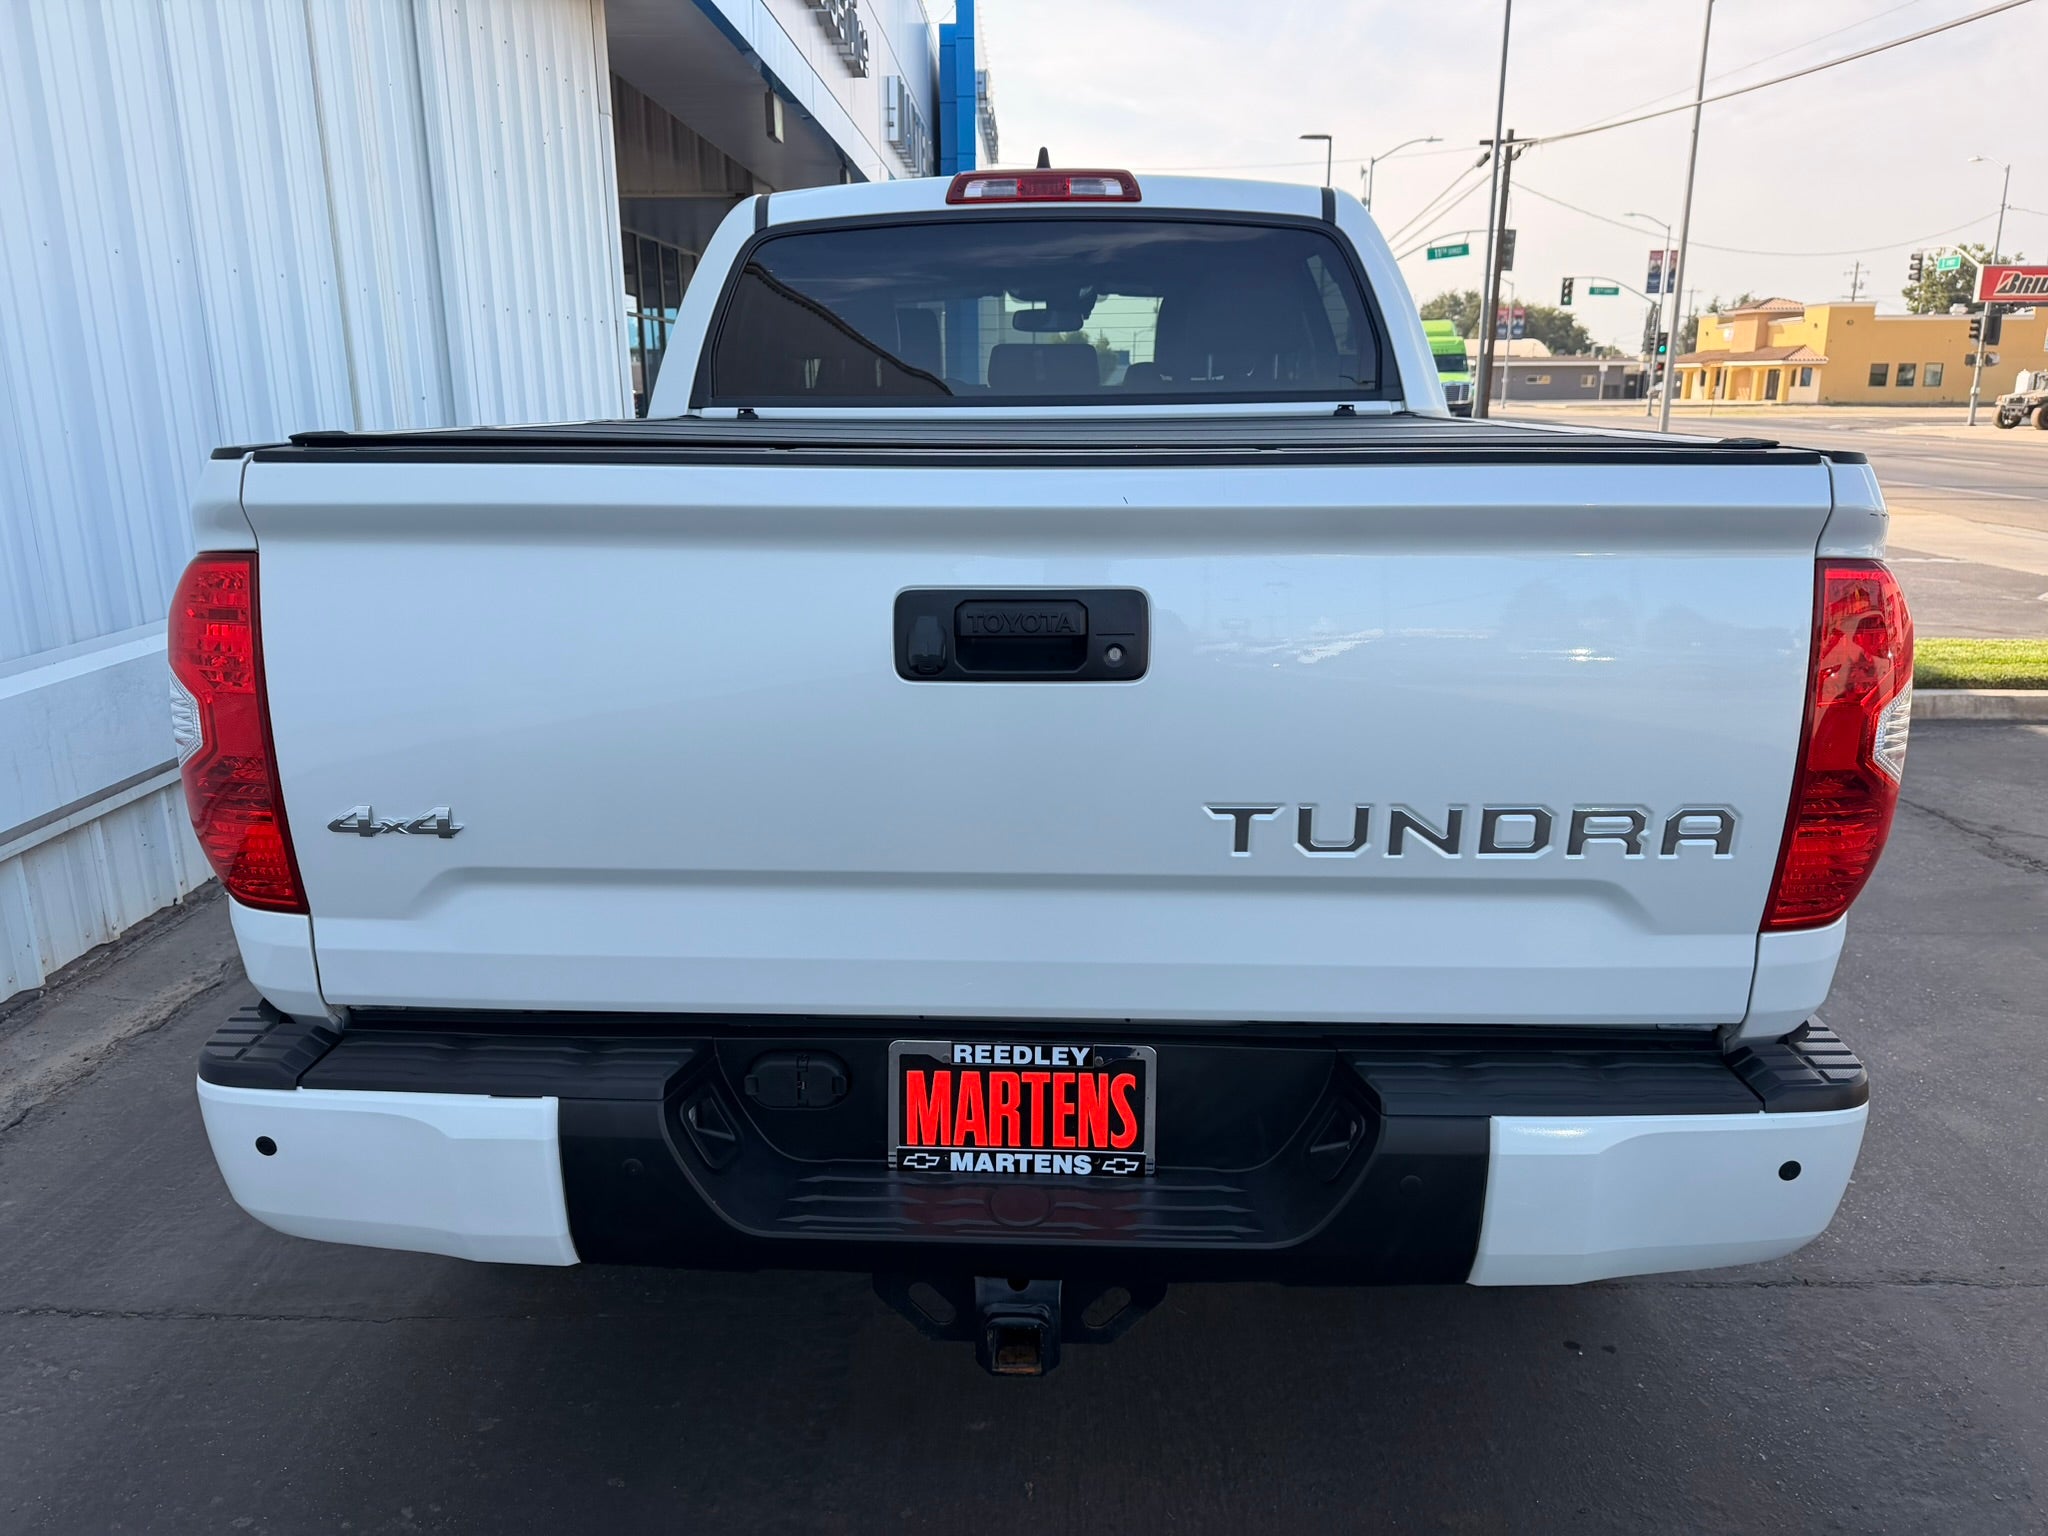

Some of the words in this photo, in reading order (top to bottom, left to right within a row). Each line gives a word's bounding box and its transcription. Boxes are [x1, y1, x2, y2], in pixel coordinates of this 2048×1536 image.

[967, 612, 1076, 633] TOYOTA
[1203, 803, 1738, 859] TUNDRA
[953, 1044, 1090, 1066] REEDLEY
[906, 1070, 1138, 1148] MARTENS
[950, 1152, 1092, 1175] MARTENS
